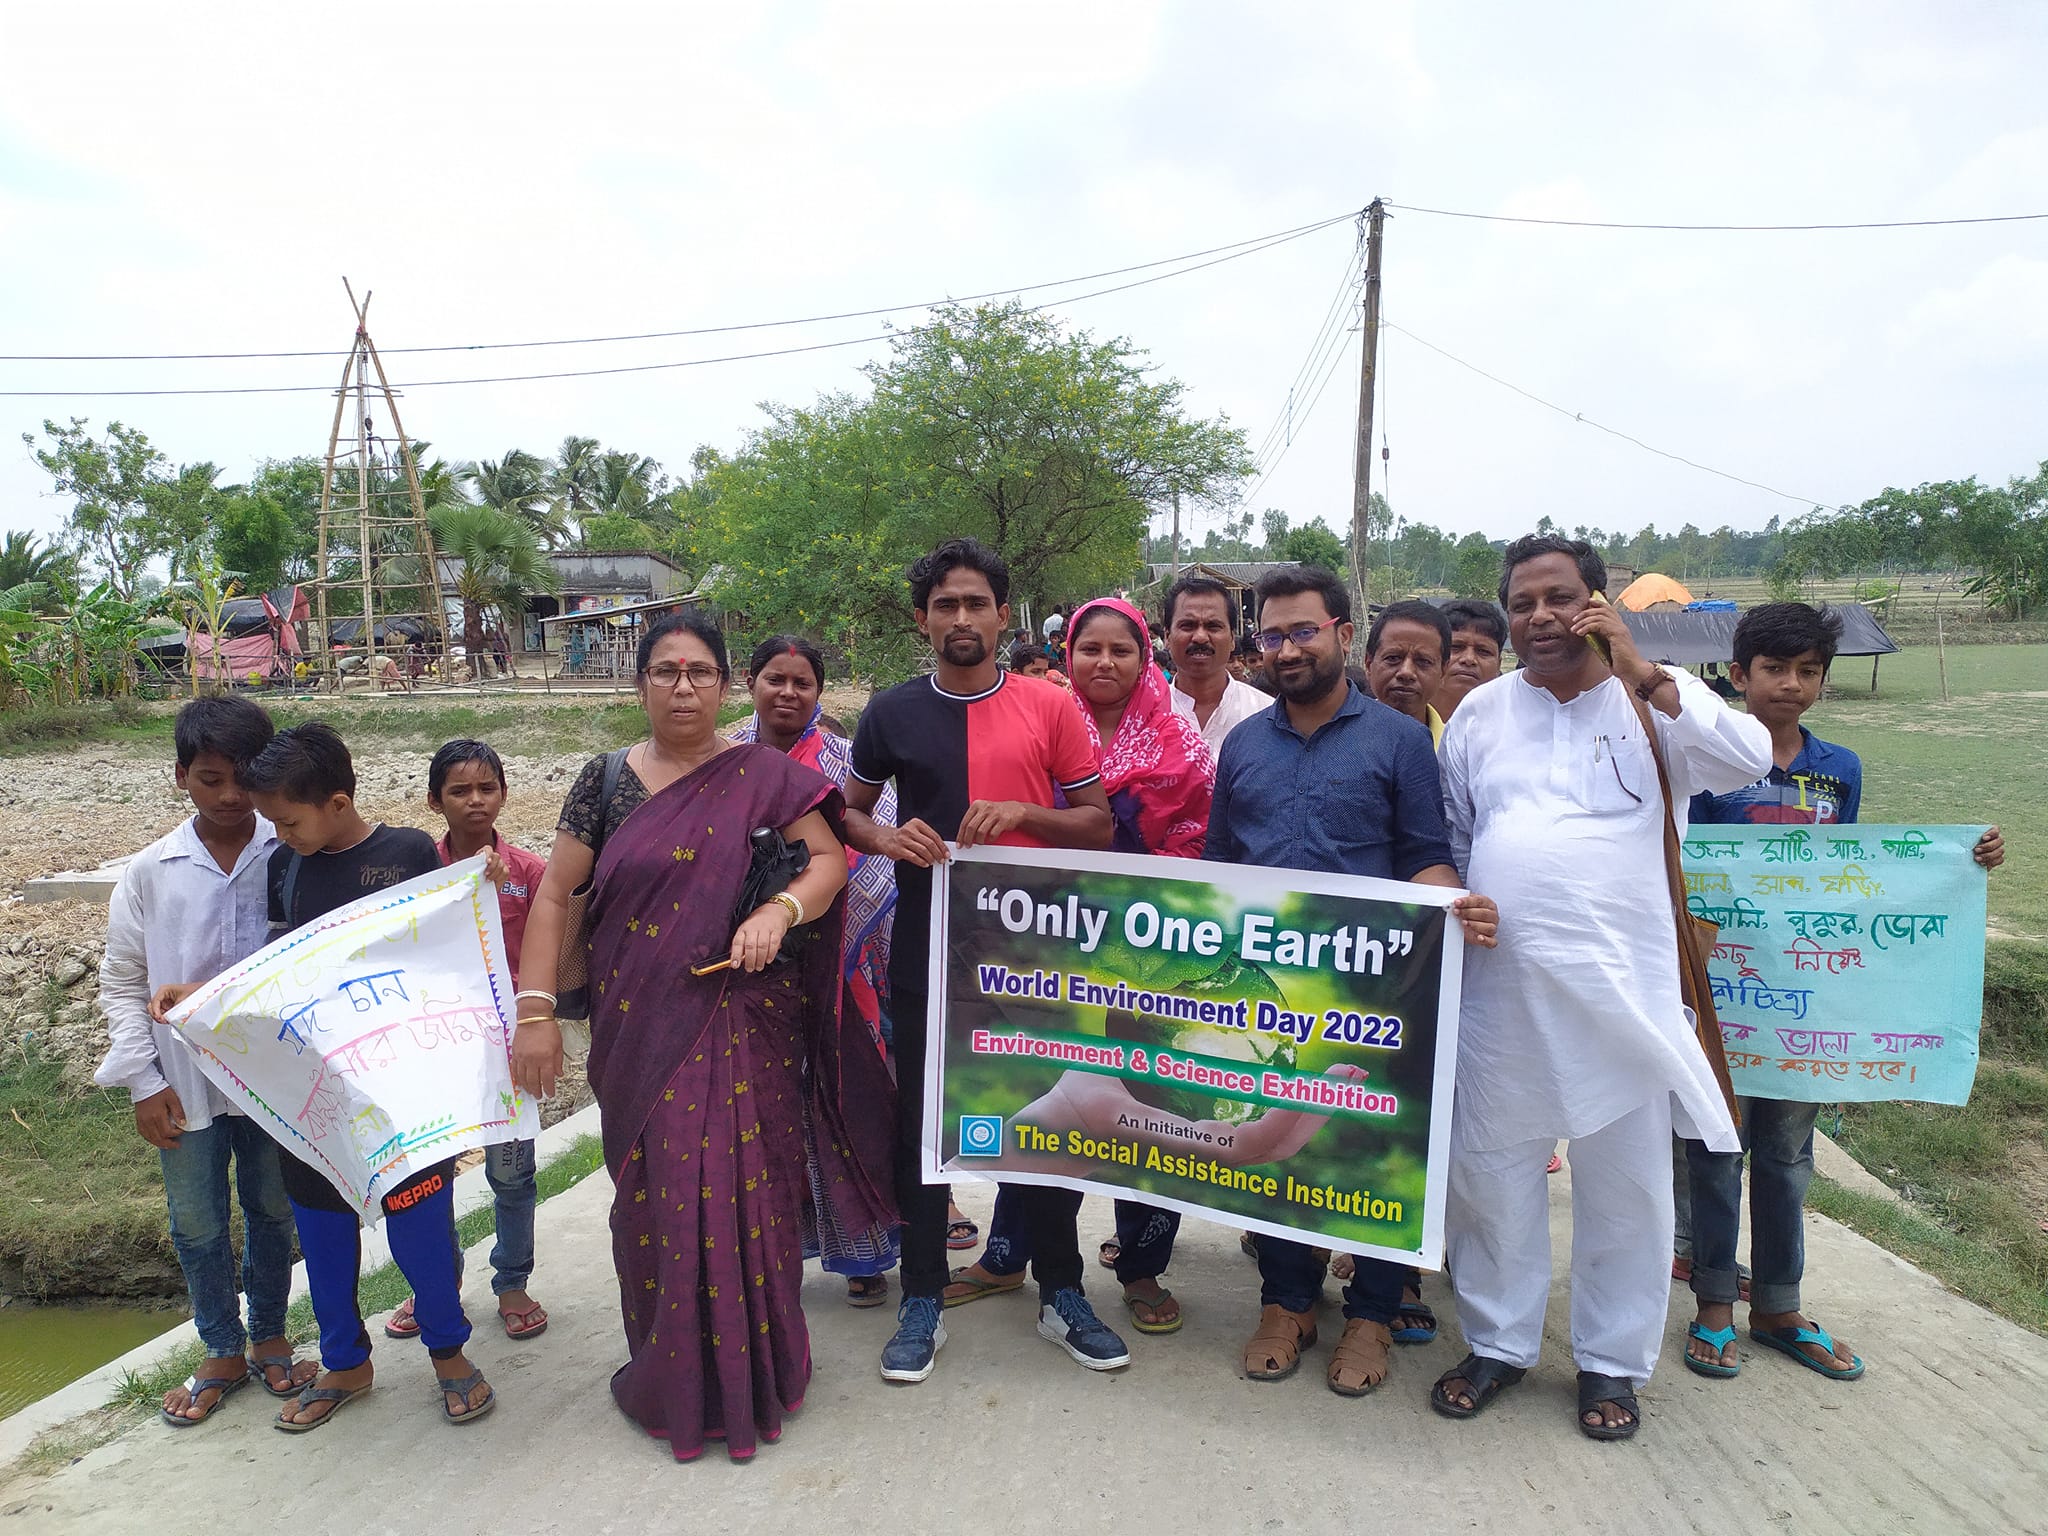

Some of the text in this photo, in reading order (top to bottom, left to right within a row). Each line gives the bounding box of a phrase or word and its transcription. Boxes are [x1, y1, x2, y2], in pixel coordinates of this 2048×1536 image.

[1124, 901, 1223, 956] One
[338, 969, 410, 1012] চান
[978, 965, 1403, 1048] World Environment Day 2022
[971, 1029, 1397, 1115] Environment & Science Exhibition
[1117, 1113, 1235, 1148] An Initiative of
[1015, 1124, 1403, 1222] The Social Assistance Instution
